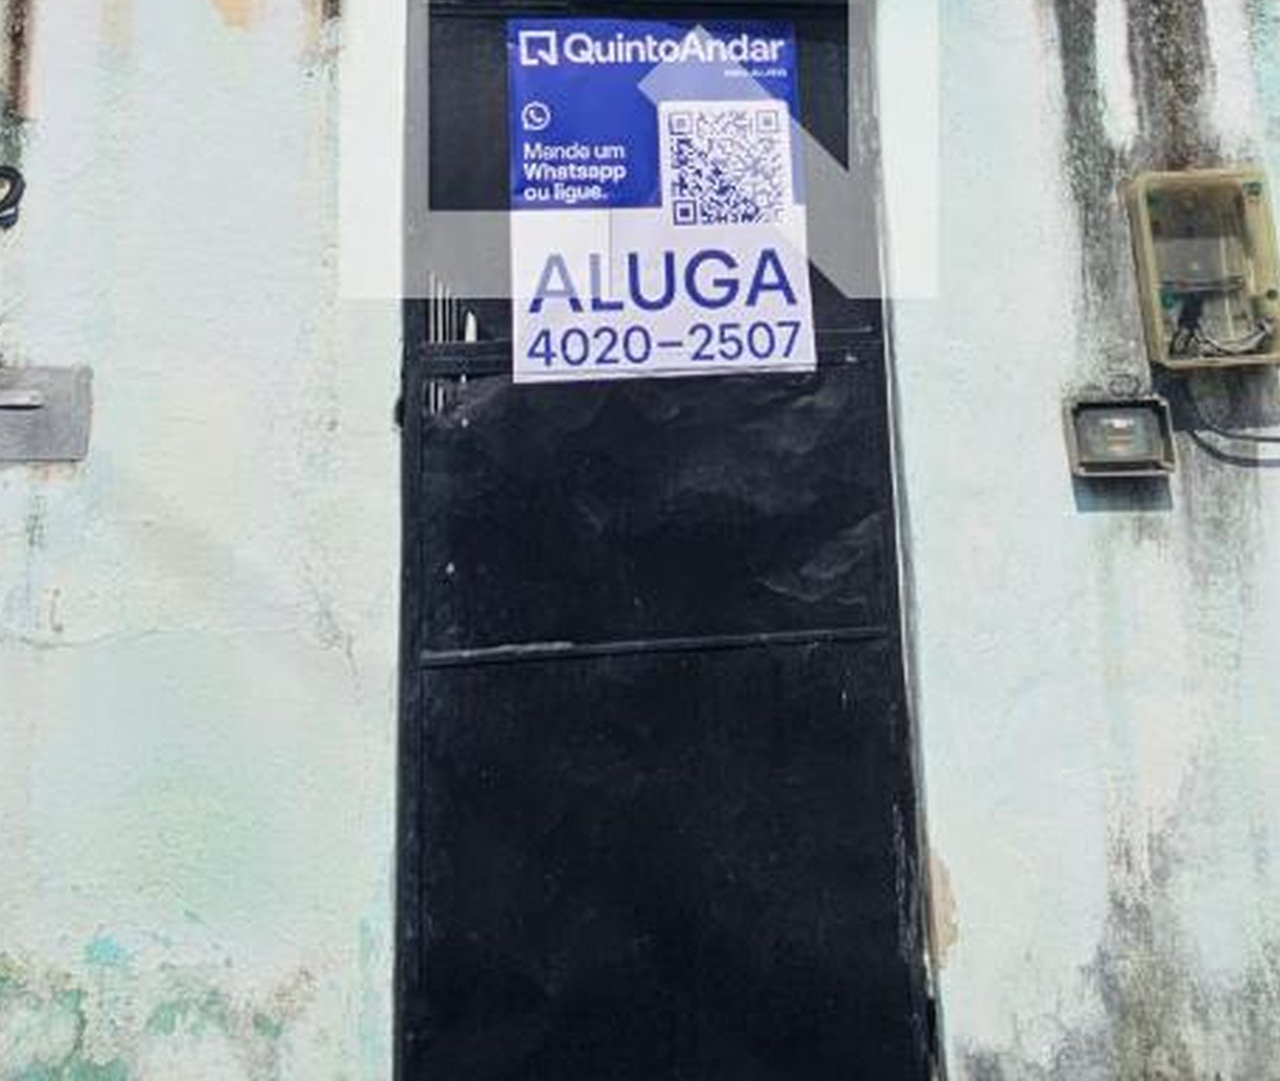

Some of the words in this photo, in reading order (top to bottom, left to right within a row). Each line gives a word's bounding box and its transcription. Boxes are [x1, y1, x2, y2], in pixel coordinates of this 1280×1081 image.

[564, 33, 785, 65] QuintoAndar
[593, 144, 626, 160] um
[523, 162, 627, 184] Whatsapp
[523, 186, 550, 201] ou
[529, 248, 798, 313] ALUGA
